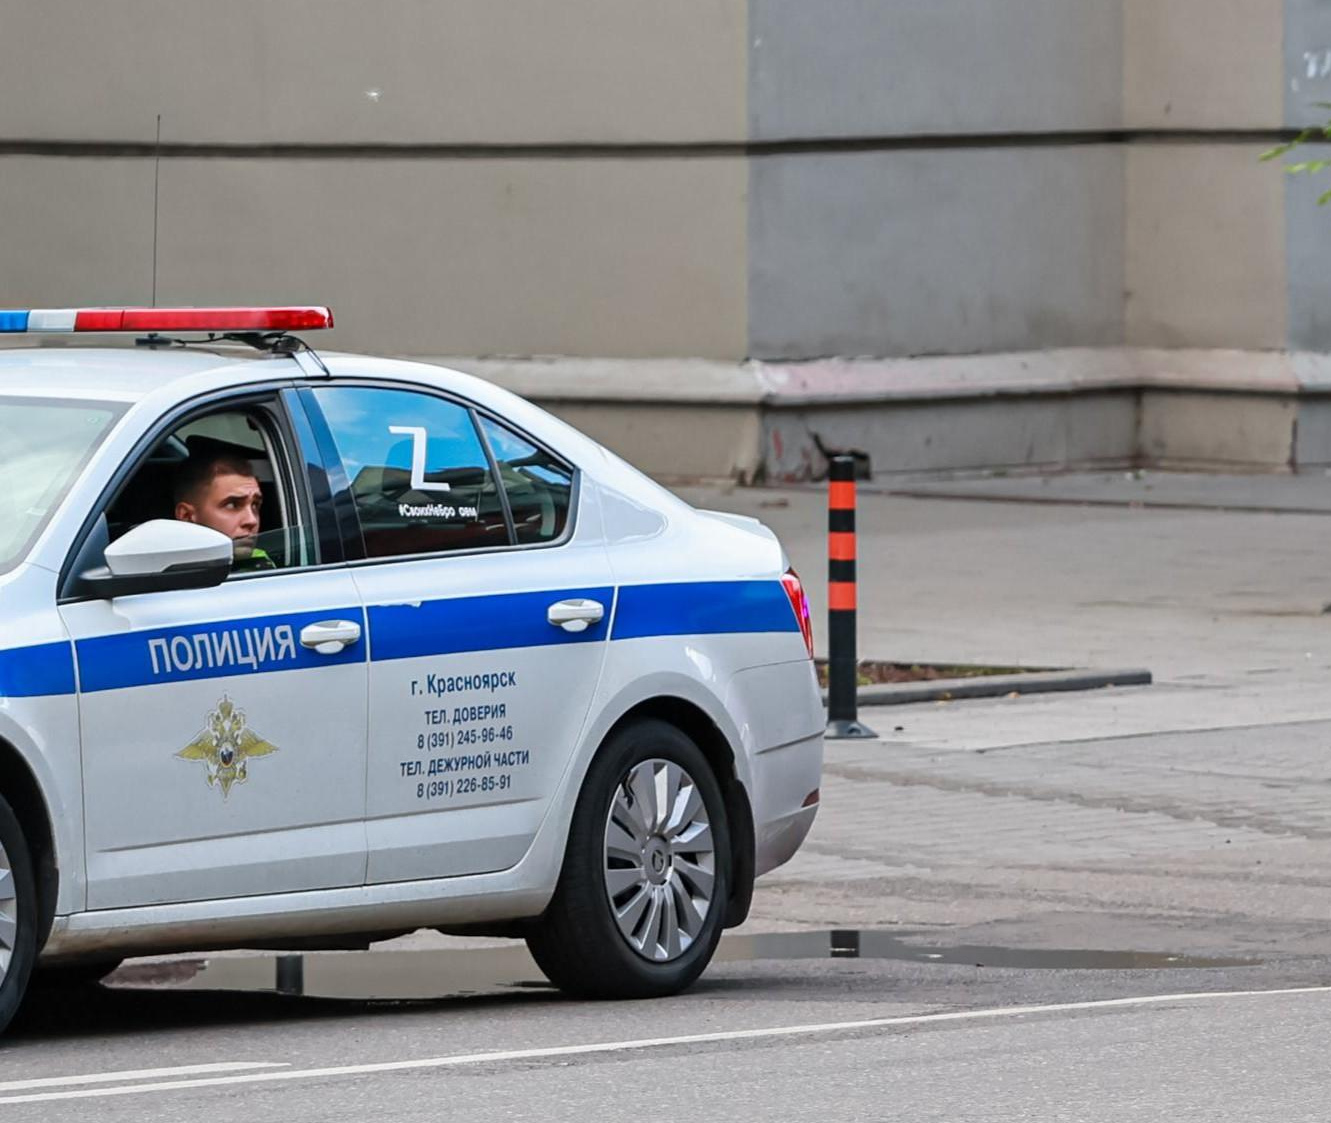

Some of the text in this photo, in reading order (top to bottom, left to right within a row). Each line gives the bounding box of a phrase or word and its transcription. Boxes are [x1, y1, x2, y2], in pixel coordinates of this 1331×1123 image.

[388, 425, 451, 492] Z
[148, 624, 297, 675] ПОЛИЦИЯ
[427, 671, 516, 697] Красноярск
[425, 703, 506, 726] ТЕЛ. ДОВЕРИЯ
[417, 725, 513, 751] 8 (391) 245-96-46
[400, 749, 530, 777] ТЕЛ. ДЕЖУРНОЙ ЧАСТИ
[416, 774, 512, 800] 8 (391) 226-85-91
